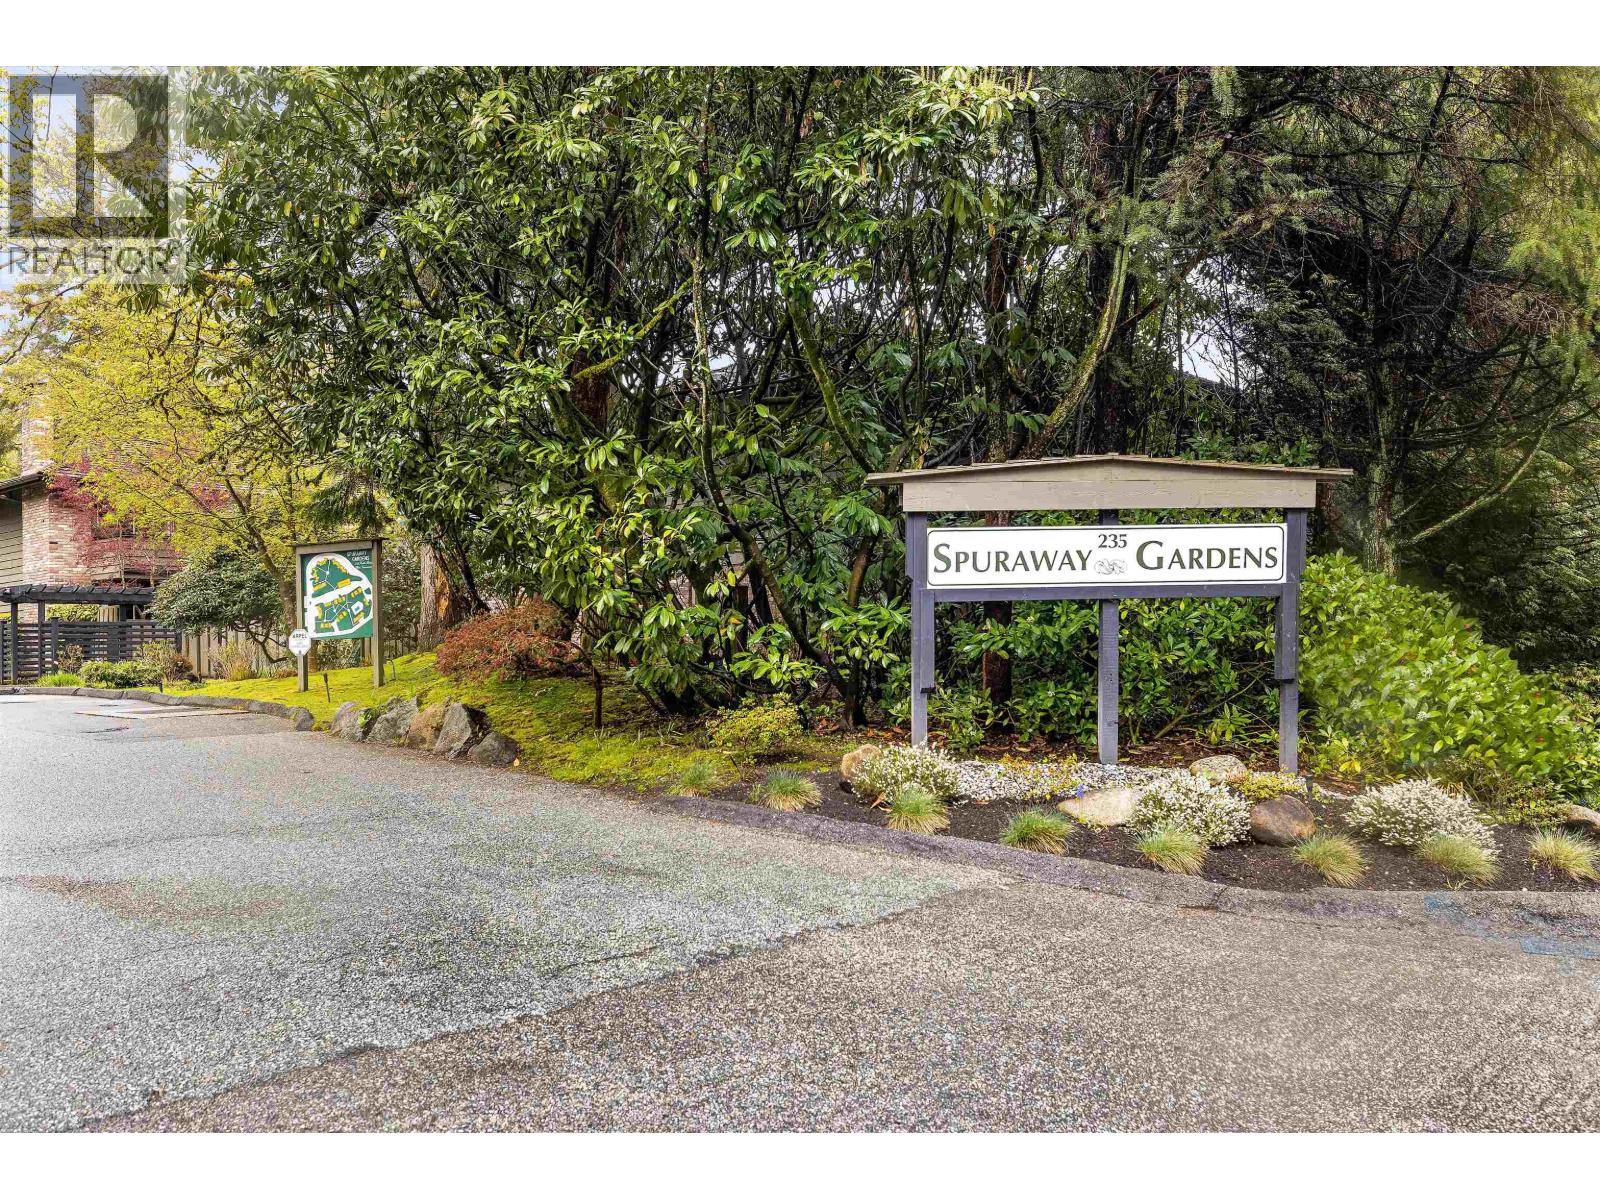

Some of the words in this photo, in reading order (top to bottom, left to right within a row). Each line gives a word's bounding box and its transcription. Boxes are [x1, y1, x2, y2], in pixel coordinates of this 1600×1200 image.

[1097, 533, 1128, 549] 235
[933, 543, 1093, 573] SPURAWAY
[1135, 540, 1278, 571] GARDENS
